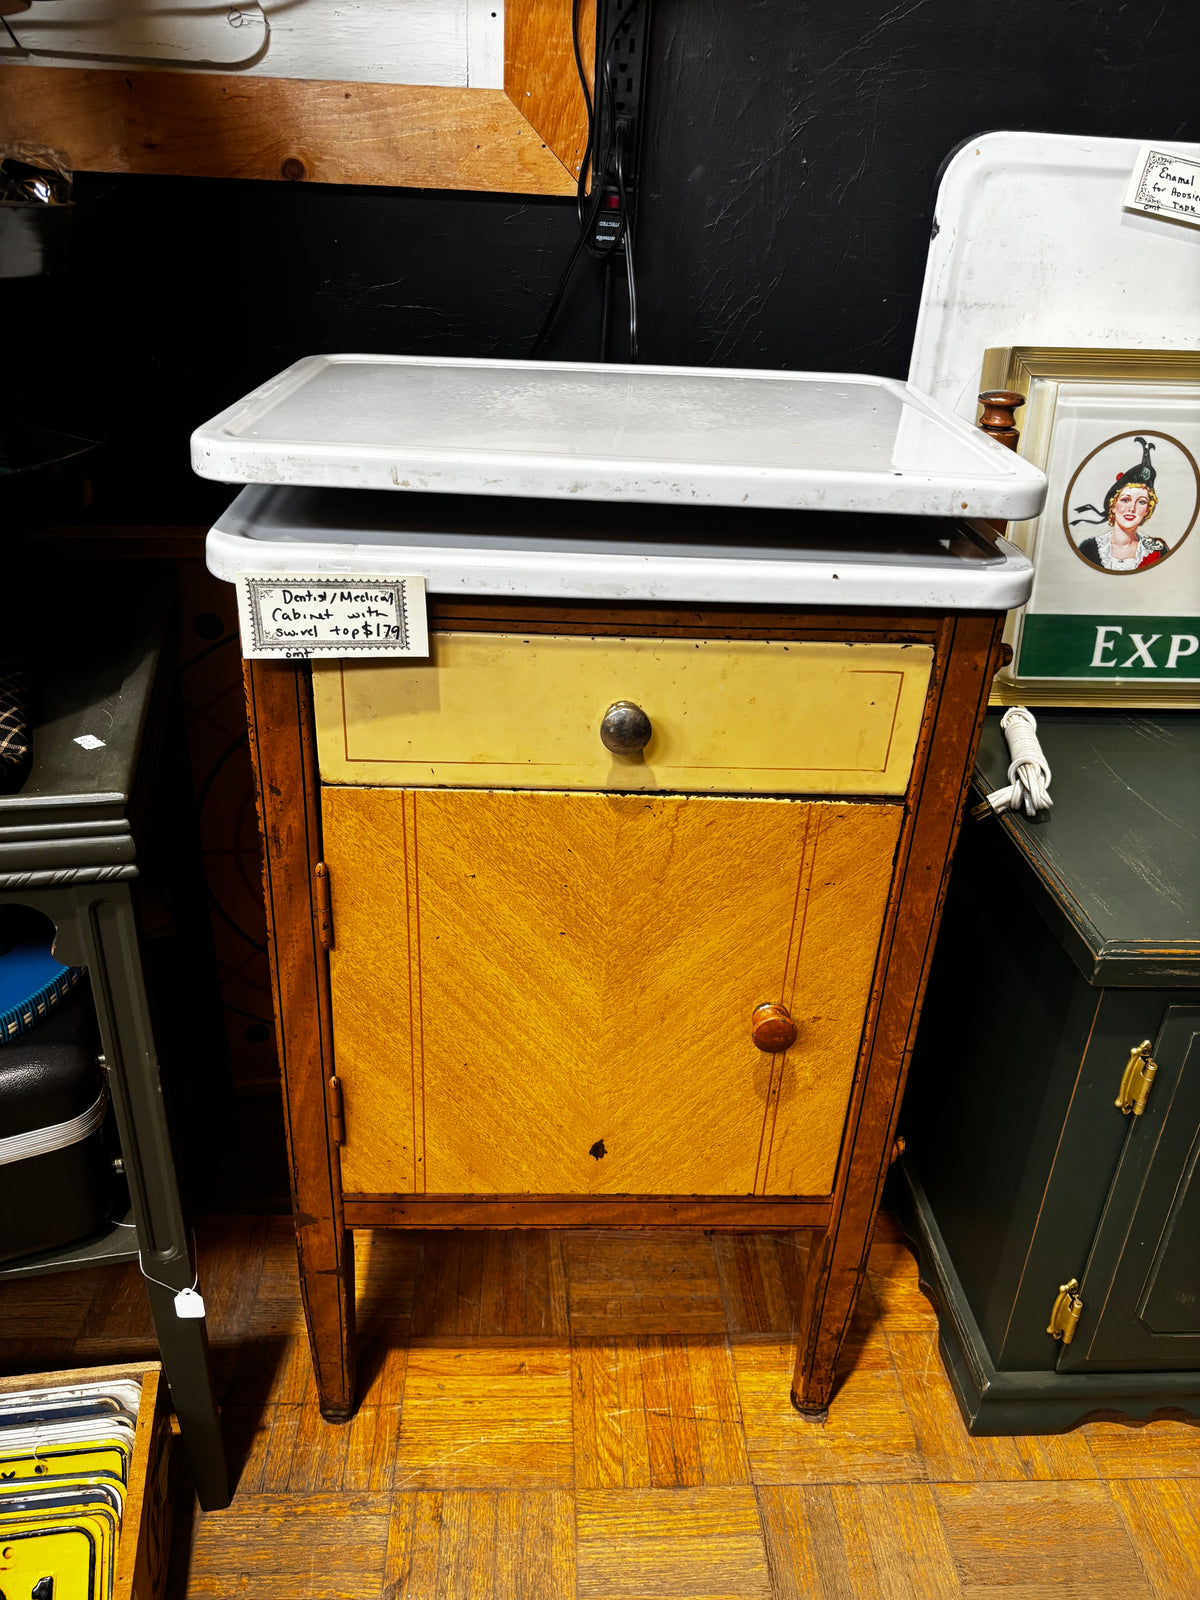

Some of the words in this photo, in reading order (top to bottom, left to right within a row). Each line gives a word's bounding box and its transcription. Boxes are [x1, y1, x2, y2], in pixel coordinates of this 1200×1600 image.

[1158, 166, 1195, 187] Enamel
[1151, 182, 1167, 193] for
[1170, 186, 1200, 202] Hoosie
[271, 607, 334, 622] Cabinet
[347, 605, 389, 620] with
